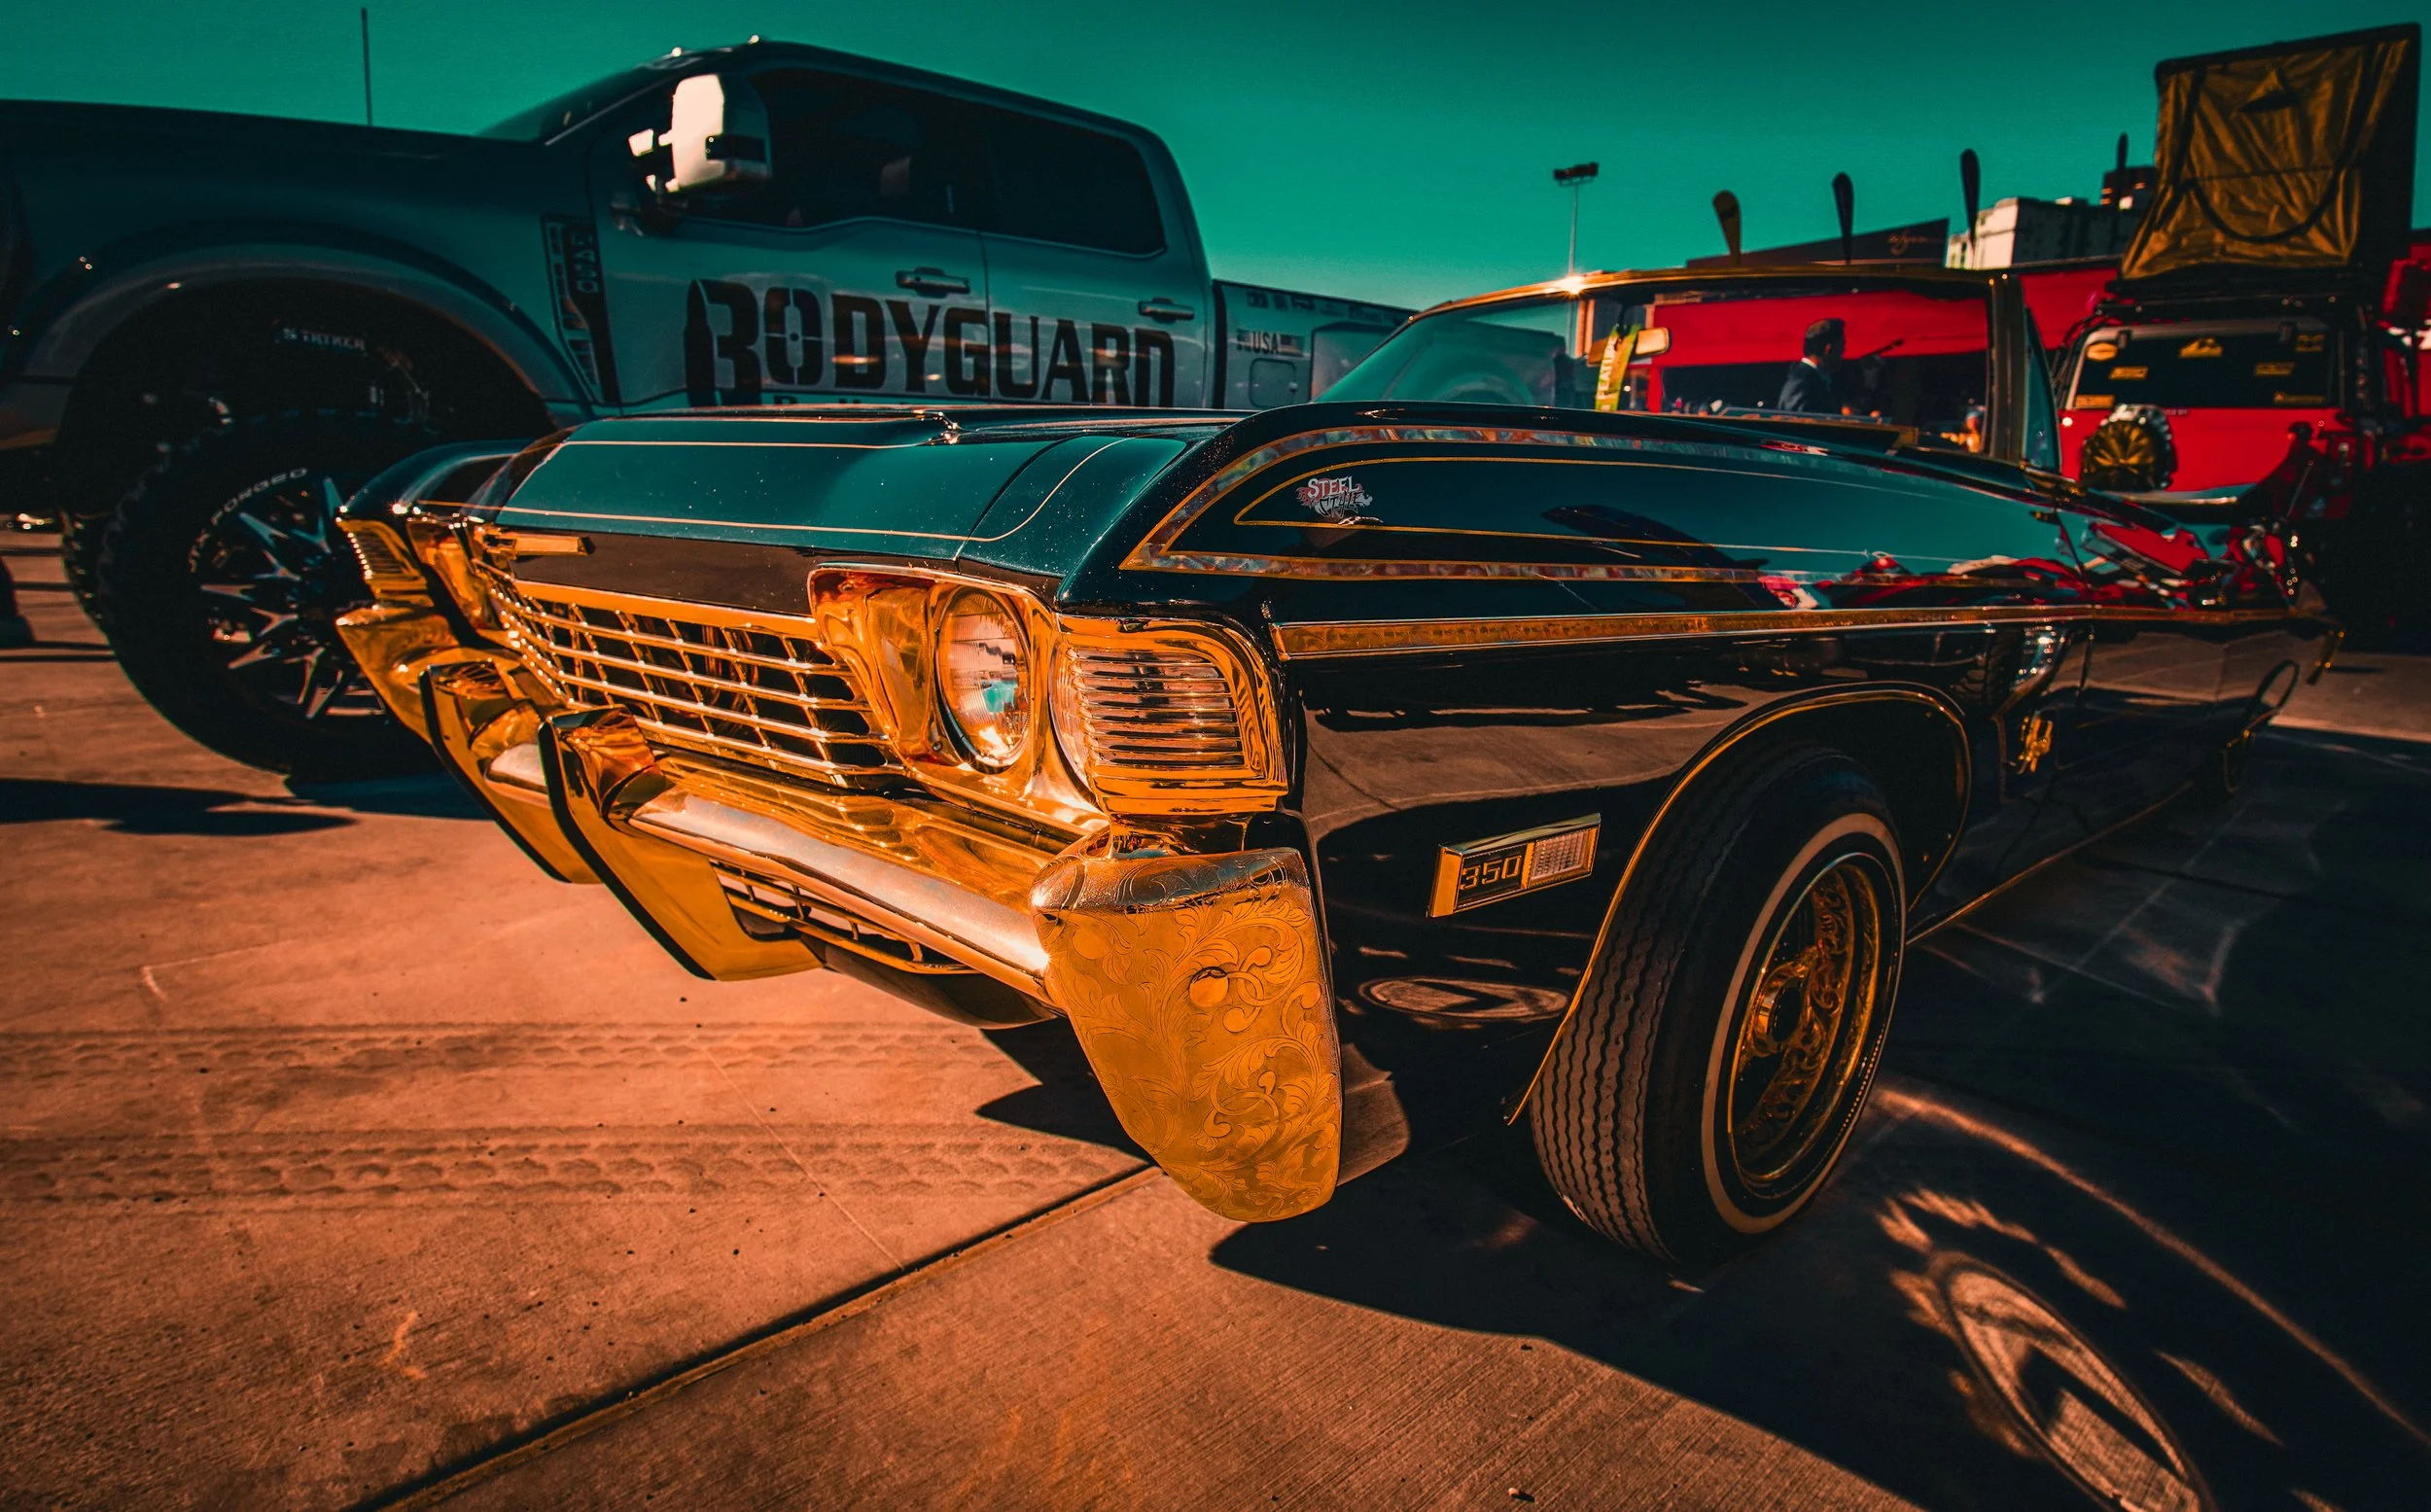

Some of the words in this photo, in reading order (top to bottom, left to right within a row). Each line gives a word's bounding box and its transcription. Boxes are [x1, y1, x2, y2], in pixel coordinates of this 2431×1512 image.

[684, 278, 1174, 407] BODYGUARD
[1252, 331, 1281, 355] USA
[210, 467, 308, 527] FORGED
[1308, 476, 1360, 499] STEEL
[1461, 855, 1522, 890] 350
